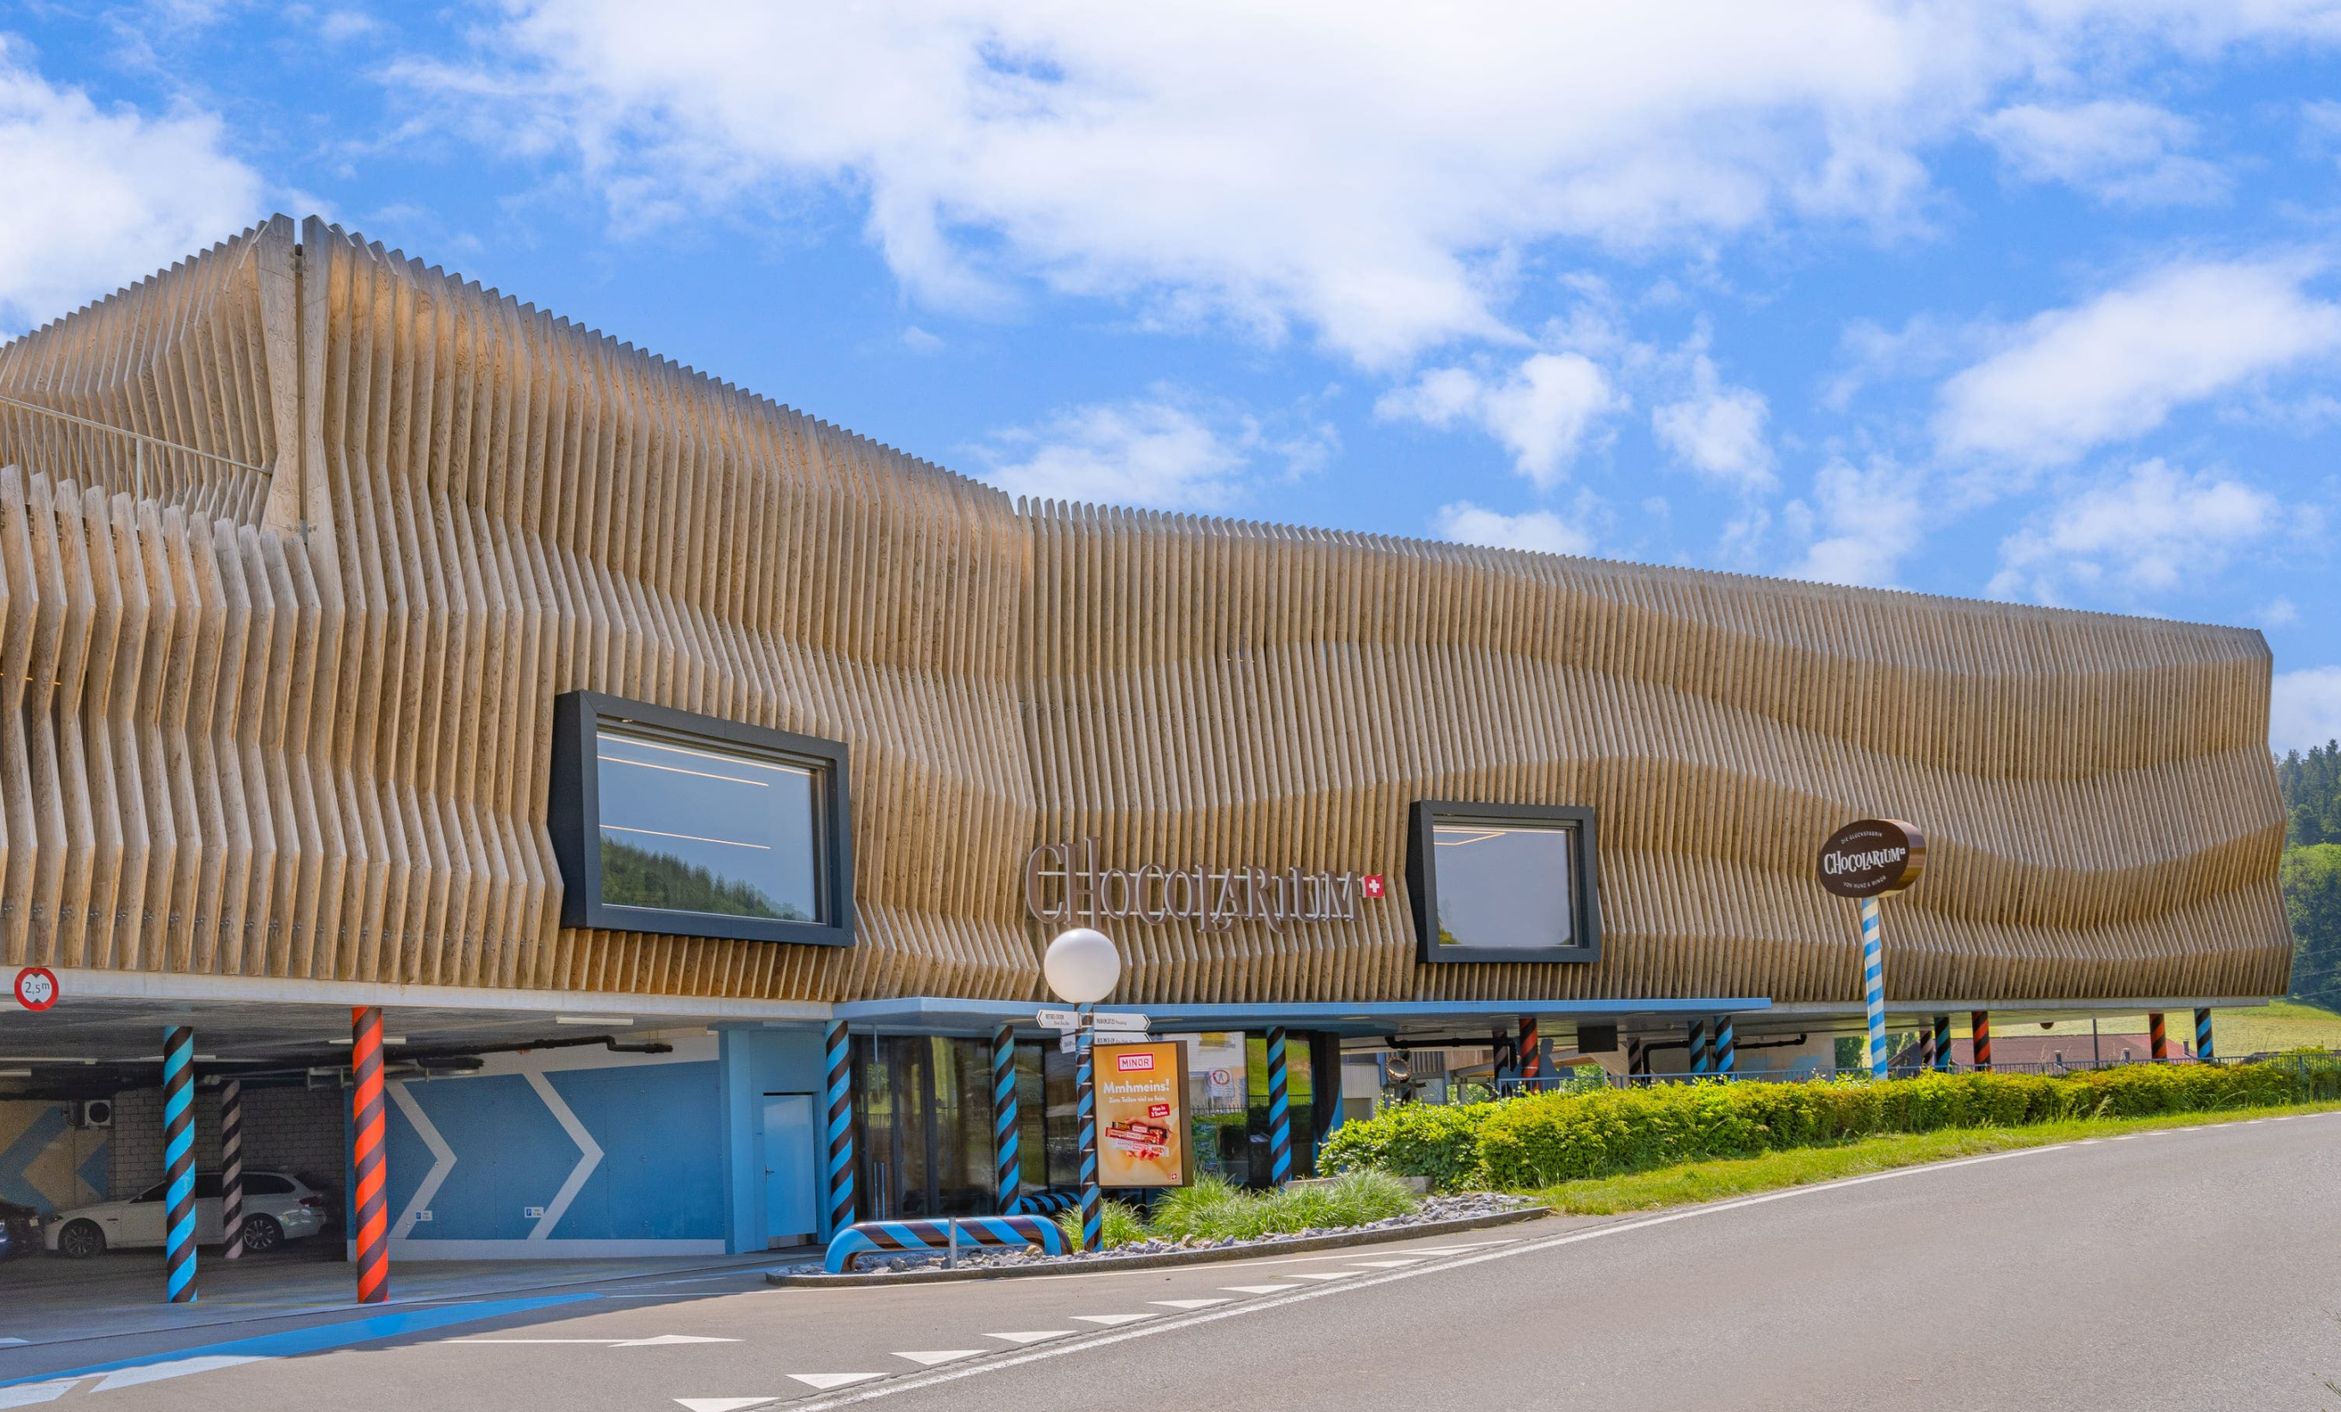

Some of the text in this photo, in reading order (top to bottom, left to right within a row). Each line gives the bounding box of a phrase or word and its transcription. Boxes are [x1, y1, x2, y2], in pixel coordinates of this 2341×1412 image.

[1824, 847, 1901, 875] CHOCOLARIUM
[1025, 836, 1363, 935] CHOCOLARIUM
[1121, 1058, 1150, 1068] MINOR
[1103, 1079, 1170, 1095] Mmhmeins!
